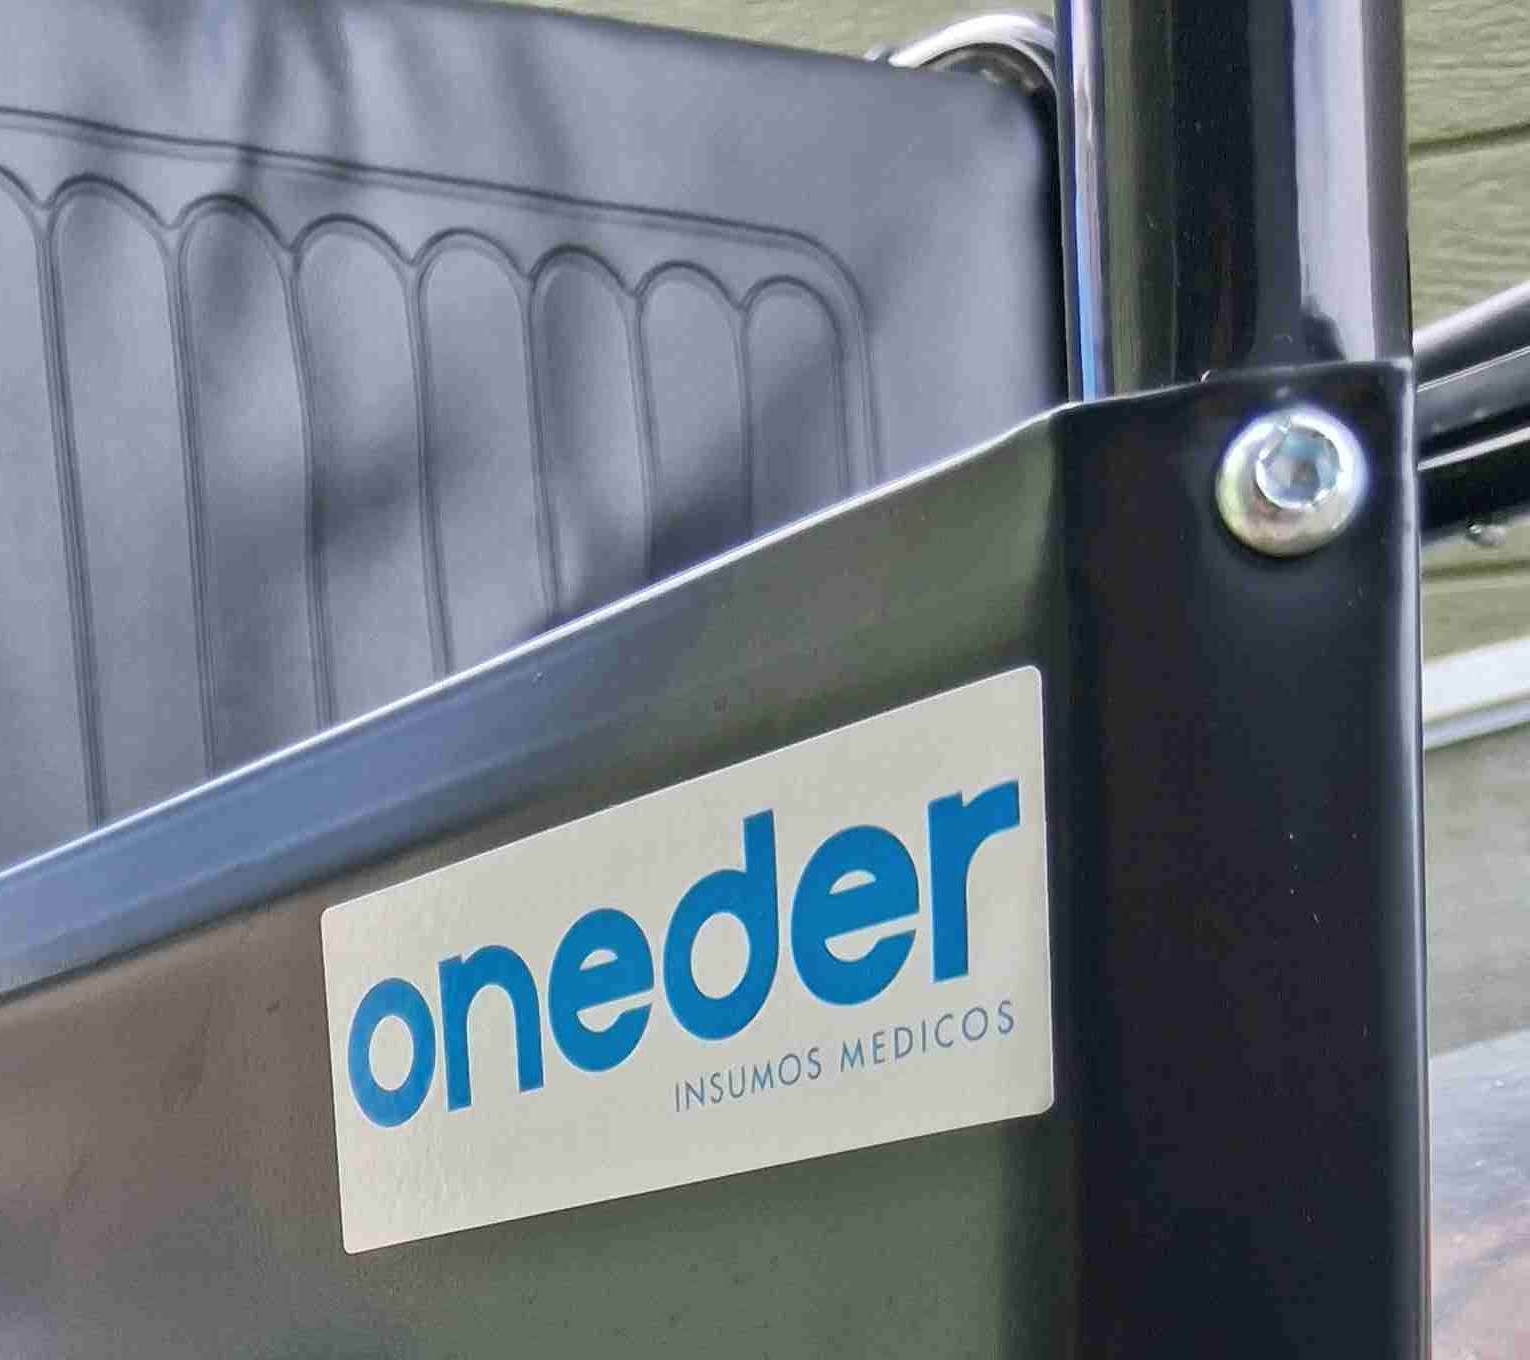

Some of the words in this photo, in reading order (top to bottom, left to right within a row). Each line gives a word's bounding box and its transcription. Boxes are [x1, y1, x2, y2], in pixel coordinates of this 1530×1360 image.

[348, 780, 1020, 1128] oneder
[674, 1048, 822, 1113] INSUMOS
[840, 1000, 1015, 1072] MEDICOS
